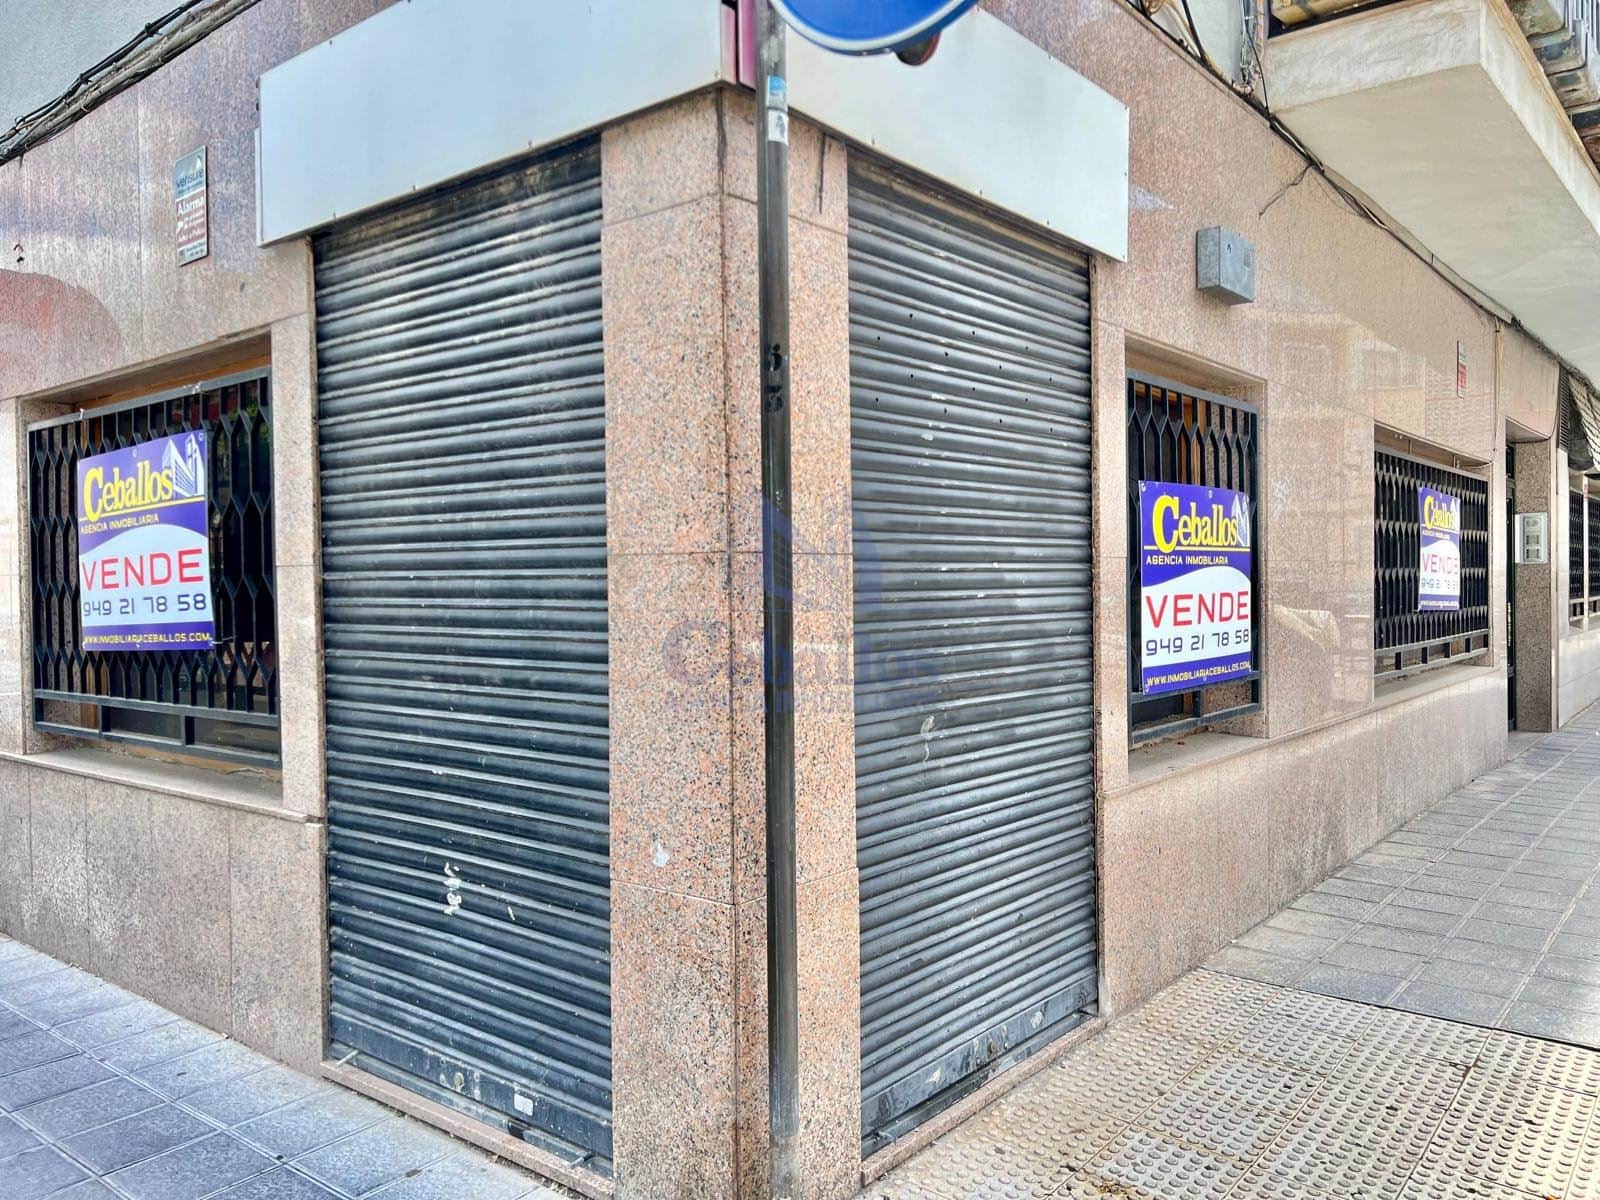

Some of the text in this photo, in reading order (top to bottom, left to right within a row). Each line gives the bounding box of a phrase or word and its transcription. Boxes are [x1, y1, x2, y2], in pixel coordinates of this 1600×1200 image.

[84, 460, 173, 522] Ceballos
[1153, 494, 1237, 553] Ceballos
[82, 548, 204, 591] VENDE
[1146, 555, 1228, 565] AGENCIA INMOBILIARIA
[1423, 552, 1458, 575] VENDE
[83, 593, 207, 616] 949 21 78 58
[1145, 591, 1249, 628] VENDE
[1146, 629, 1249, 656] 949 21 78 58
